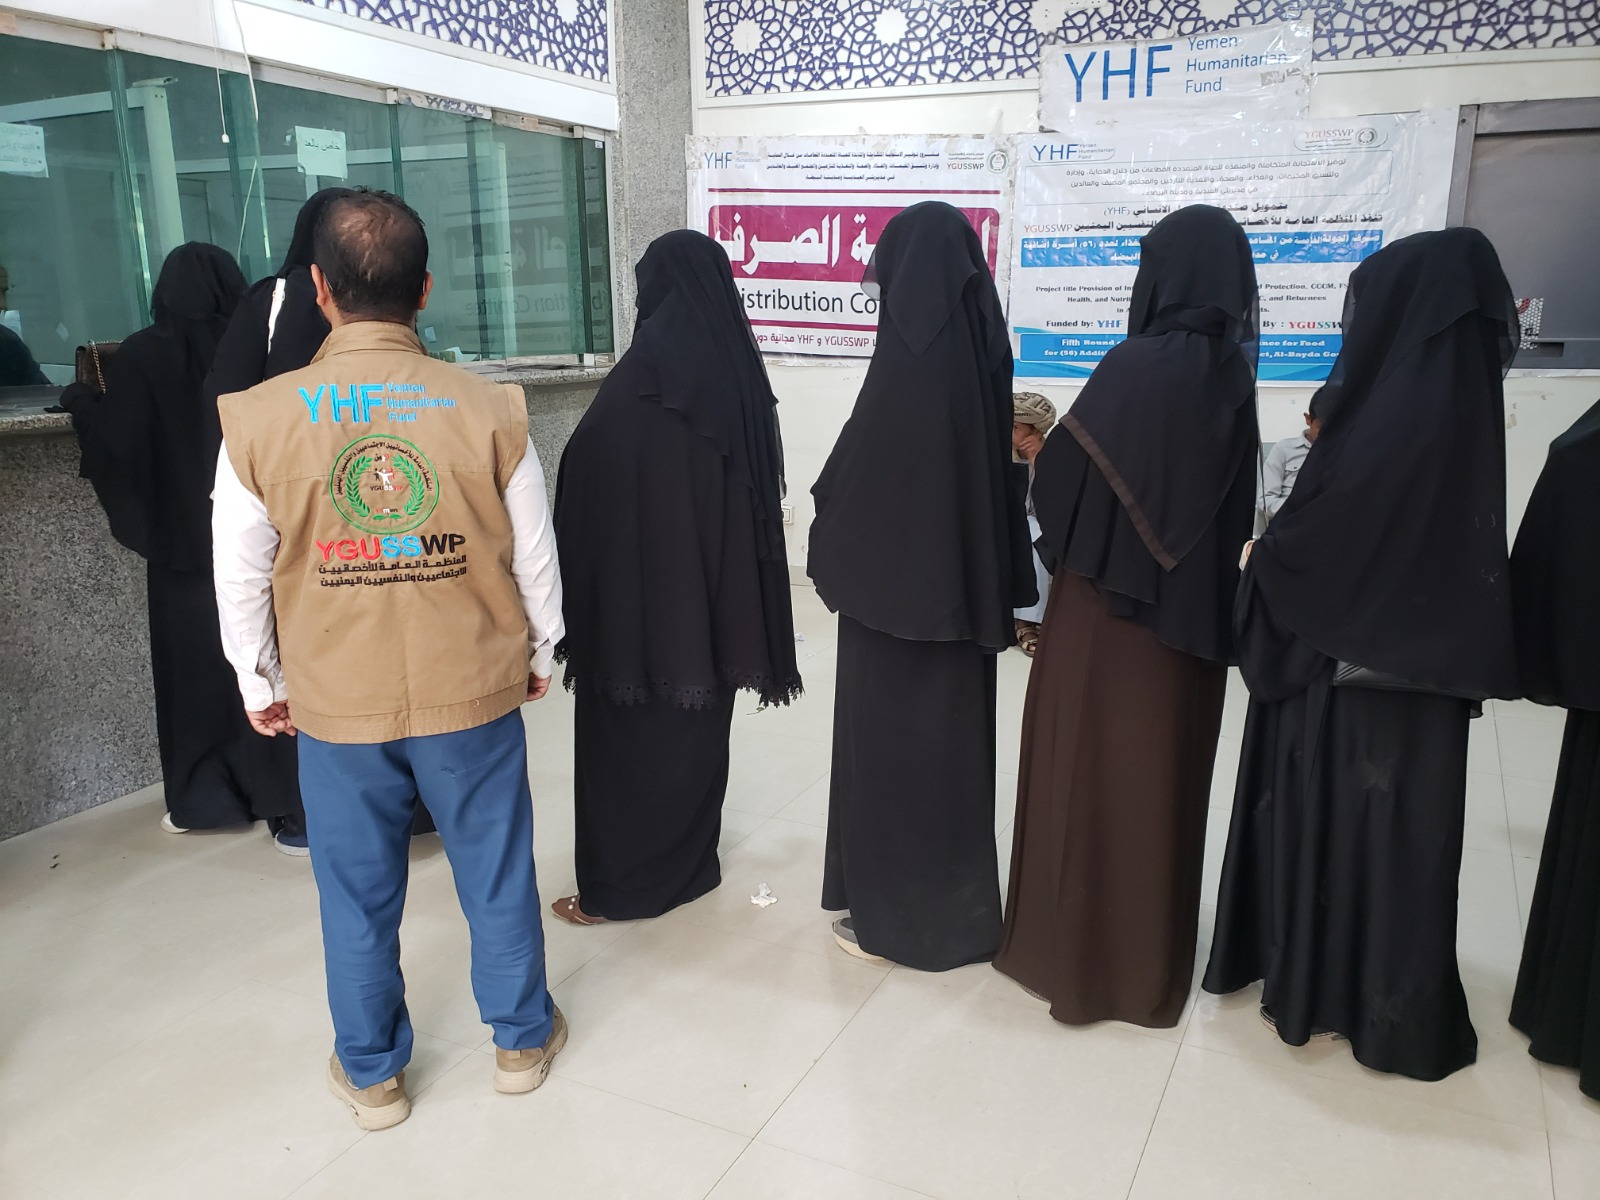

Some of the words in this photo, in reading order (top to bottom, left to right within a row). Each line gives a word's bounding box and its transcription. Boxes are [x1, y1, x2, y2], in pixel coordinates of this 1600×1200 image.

[1188, 36, 1237, 52] Yemen
[1186, 52, 1288, 72] Humanitarian
[1065, 44, 1173, 103] YHF
[1185, 77, 1223, 94] Fund
[1305, 128, 1354, 139] YGUSSWP
[1033, 144, 1079, 161] YHF
[705, 152, 733, 169] YHF
[1024, 224, 1073, 233] YGUSSWP
[741, 288, 843, 313] istribution
[1081, 320, 1094, 328] by:
[1097, 320, 1123, 328] YHF
[1263, 321, 1277, 329] By
[771, 333, 795, 344] مجانية
[797, 334, 814, 344] YHF
[817, 337, 822, 346] و
[825, 336, 870, 347] YGUSSWP
[386, 382, 426, 393] Yemen
[298, 384, 384, 423] YHF
[386, 396, 456, 409] Humanitarian
[389, 412, 417, 422] Fund
[315, 534, 466, 561] YGUSSWP
[379, 560, 421, 571] العامة
[422, 555, 467, 568] المنظمة
[364, 573, 416, 586] والنفسيين
[417, 567, 467, 582] الاجتماعيين
[321, 576, 362, 587] اليمنيين
